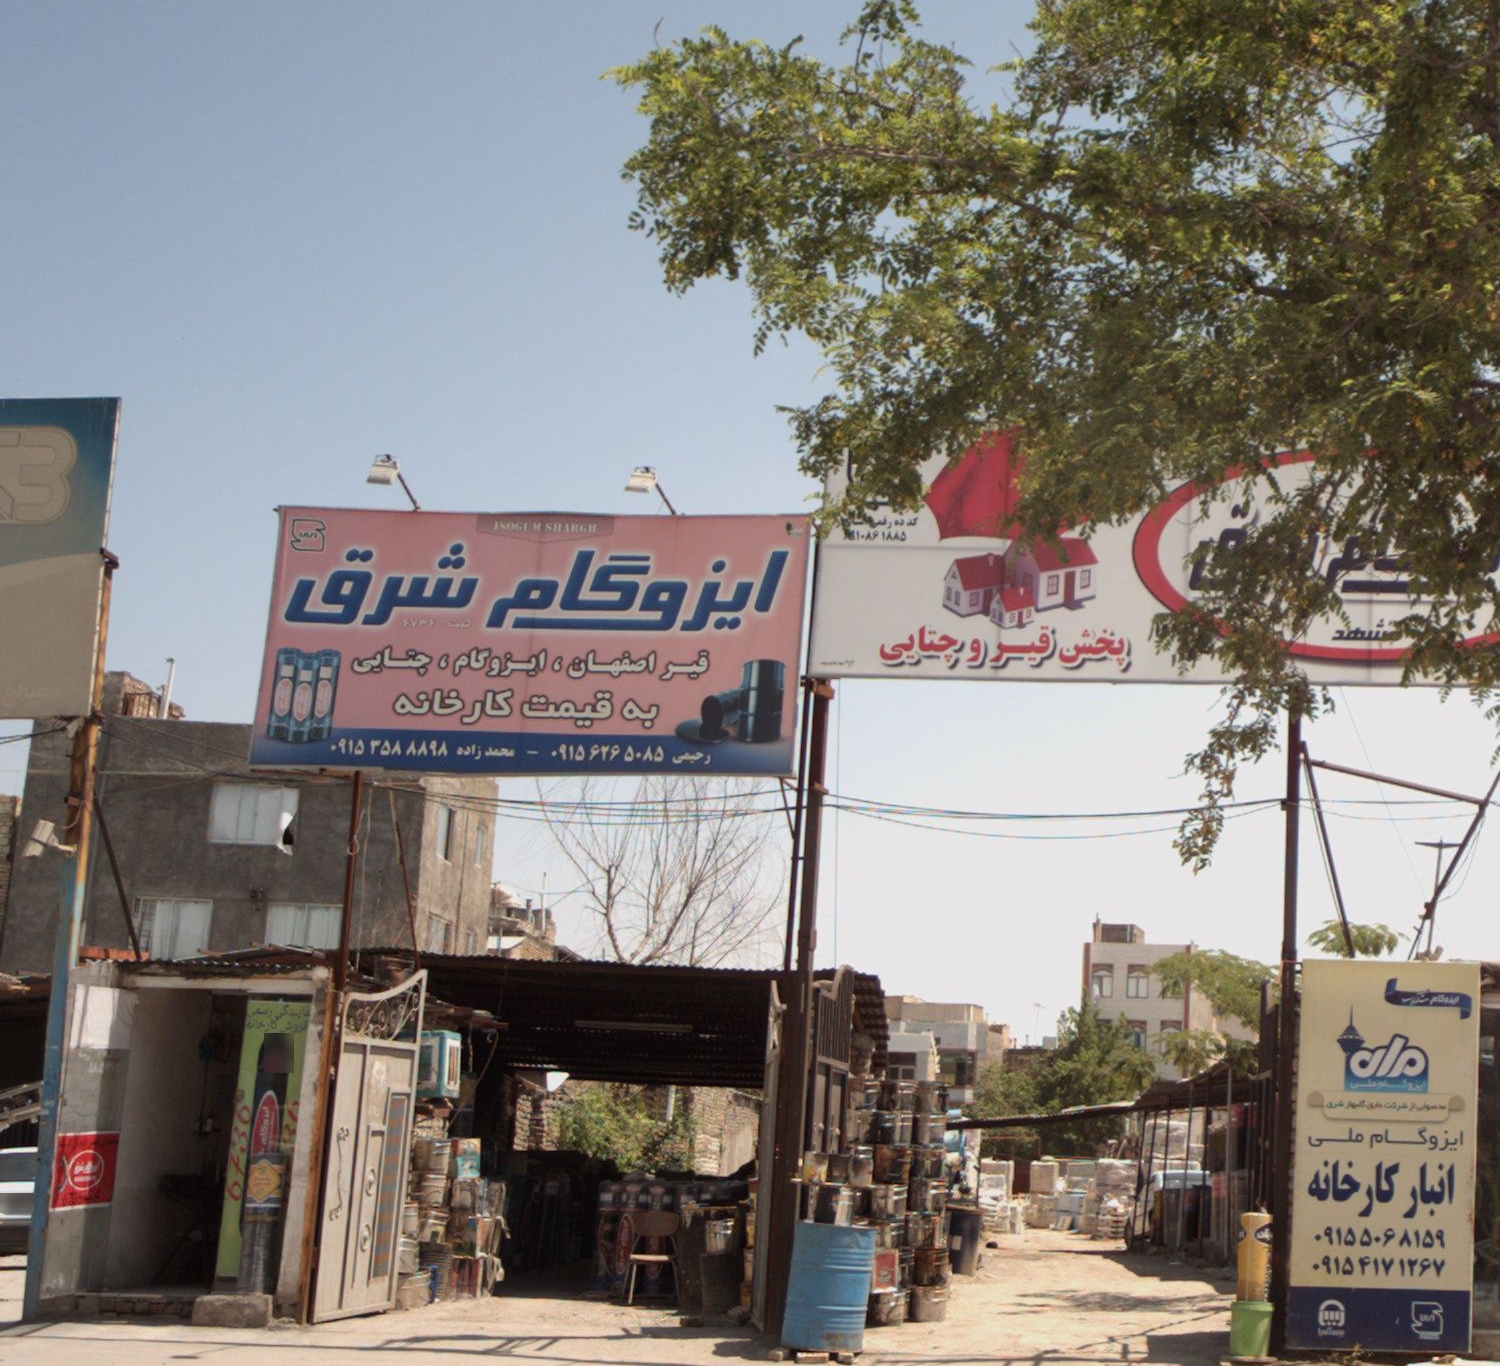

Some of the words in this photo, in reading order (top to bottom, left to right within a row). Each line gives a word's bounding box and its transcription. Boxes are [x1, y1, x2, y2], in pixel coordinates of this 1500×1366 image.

[494, 521, 541, 532] ISOGUM
[545, 522, 597, 533] SHARGH
[284, 543, 479, 625] شرق
[485, 550, 789, 631] ایزوگام
[352, 646, 432, 675] چتایی
[453, 647, 547, 677] ایزوگام
[879, 625, 962, 667] چتایی
[965, 640, 986, 666] و
[990, 625, 1053, 668] قیر
[1058, 628, 1129, 669] پخش
[567, 649, 656, 679] اصفهان
[660, 650, 709, 681] قیر
[393, 688, 513, 725] کارخانه
[521, 690, 614, 727] قیمت
[621, 698, 659, 728] به
[1308, 1127, 1364, 1147] ملی
[1370, 1127, 1463, 1151] ایزوگام
[1308, 1159, 1400, 1217] کارخانه
[1403, 1162, 1455, 1218] انبار
